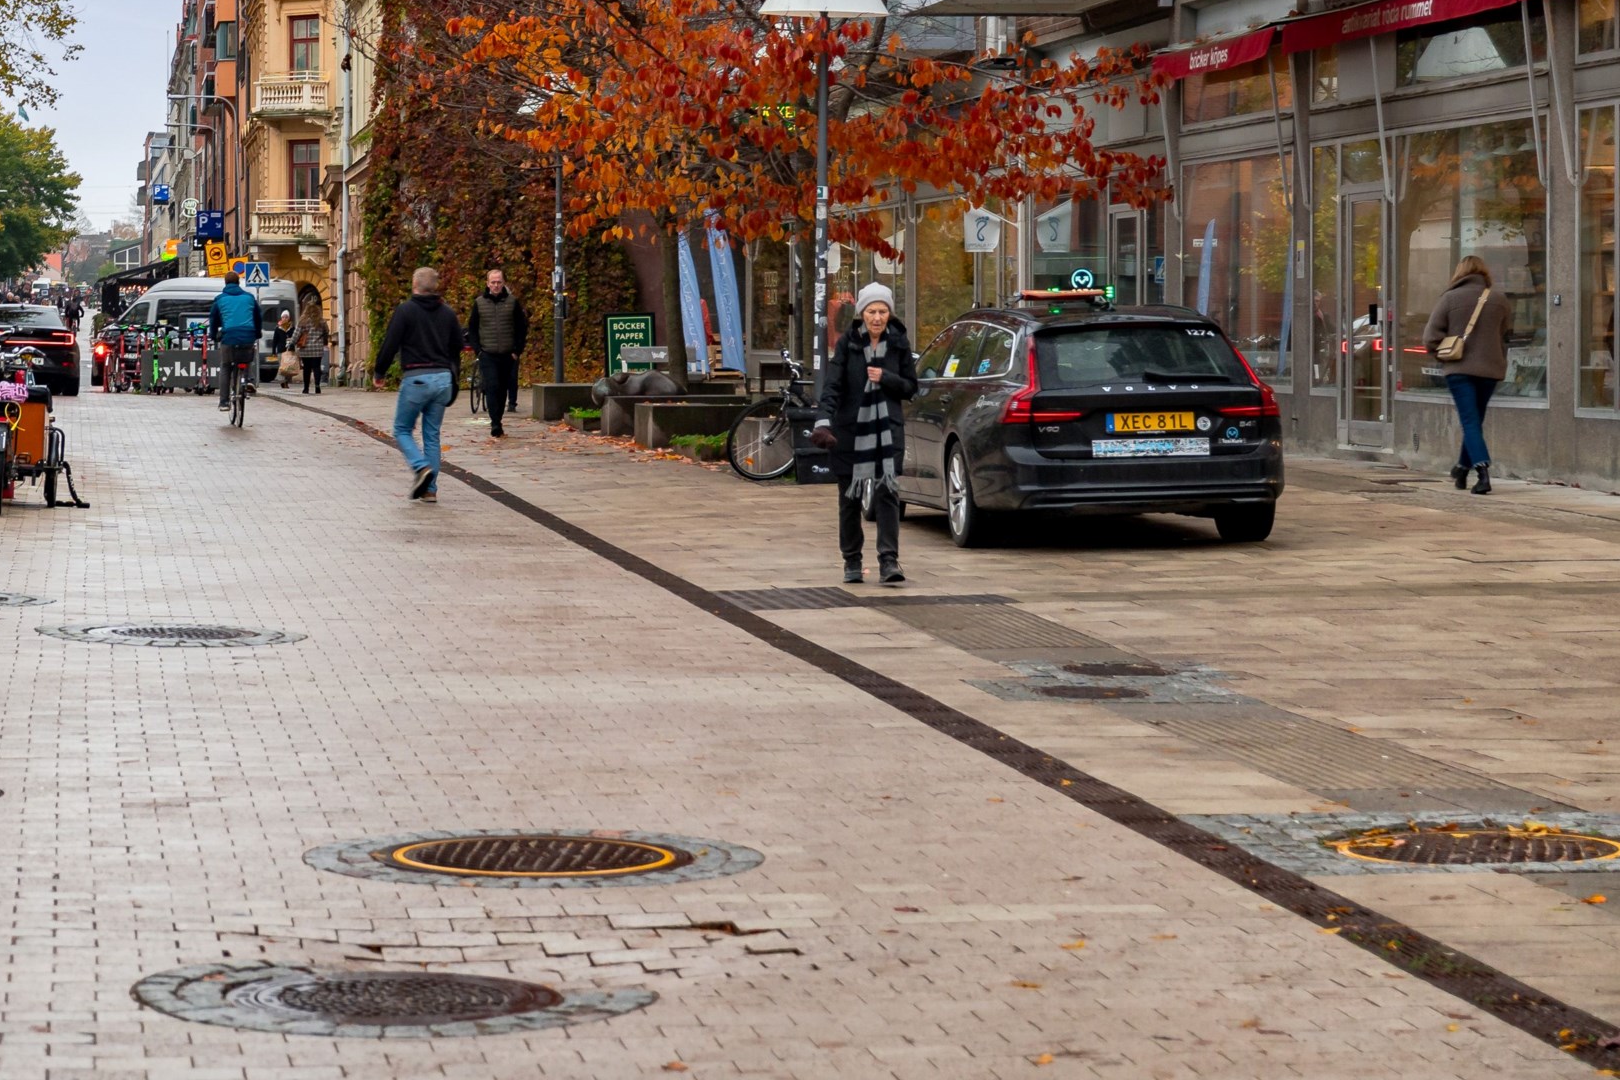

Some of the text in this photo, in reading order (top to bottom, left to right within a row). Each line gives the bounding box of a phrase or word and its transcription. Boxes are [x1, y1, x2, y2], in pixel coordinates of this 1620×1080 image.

[1189, 46, 1229, 70] böcker köpes
[199, 217, 208, 228] P
[613, 322, 646, 330] BÖCKER
[615, 332, 644, 340] PAPPER
[1185, 329, 1215, 337] 1274
[157, 361, 221, 381] yklar
[1101, 384, 1199, 392] VOLVO
[1121, 413, 1188, 430] XEC 81L
